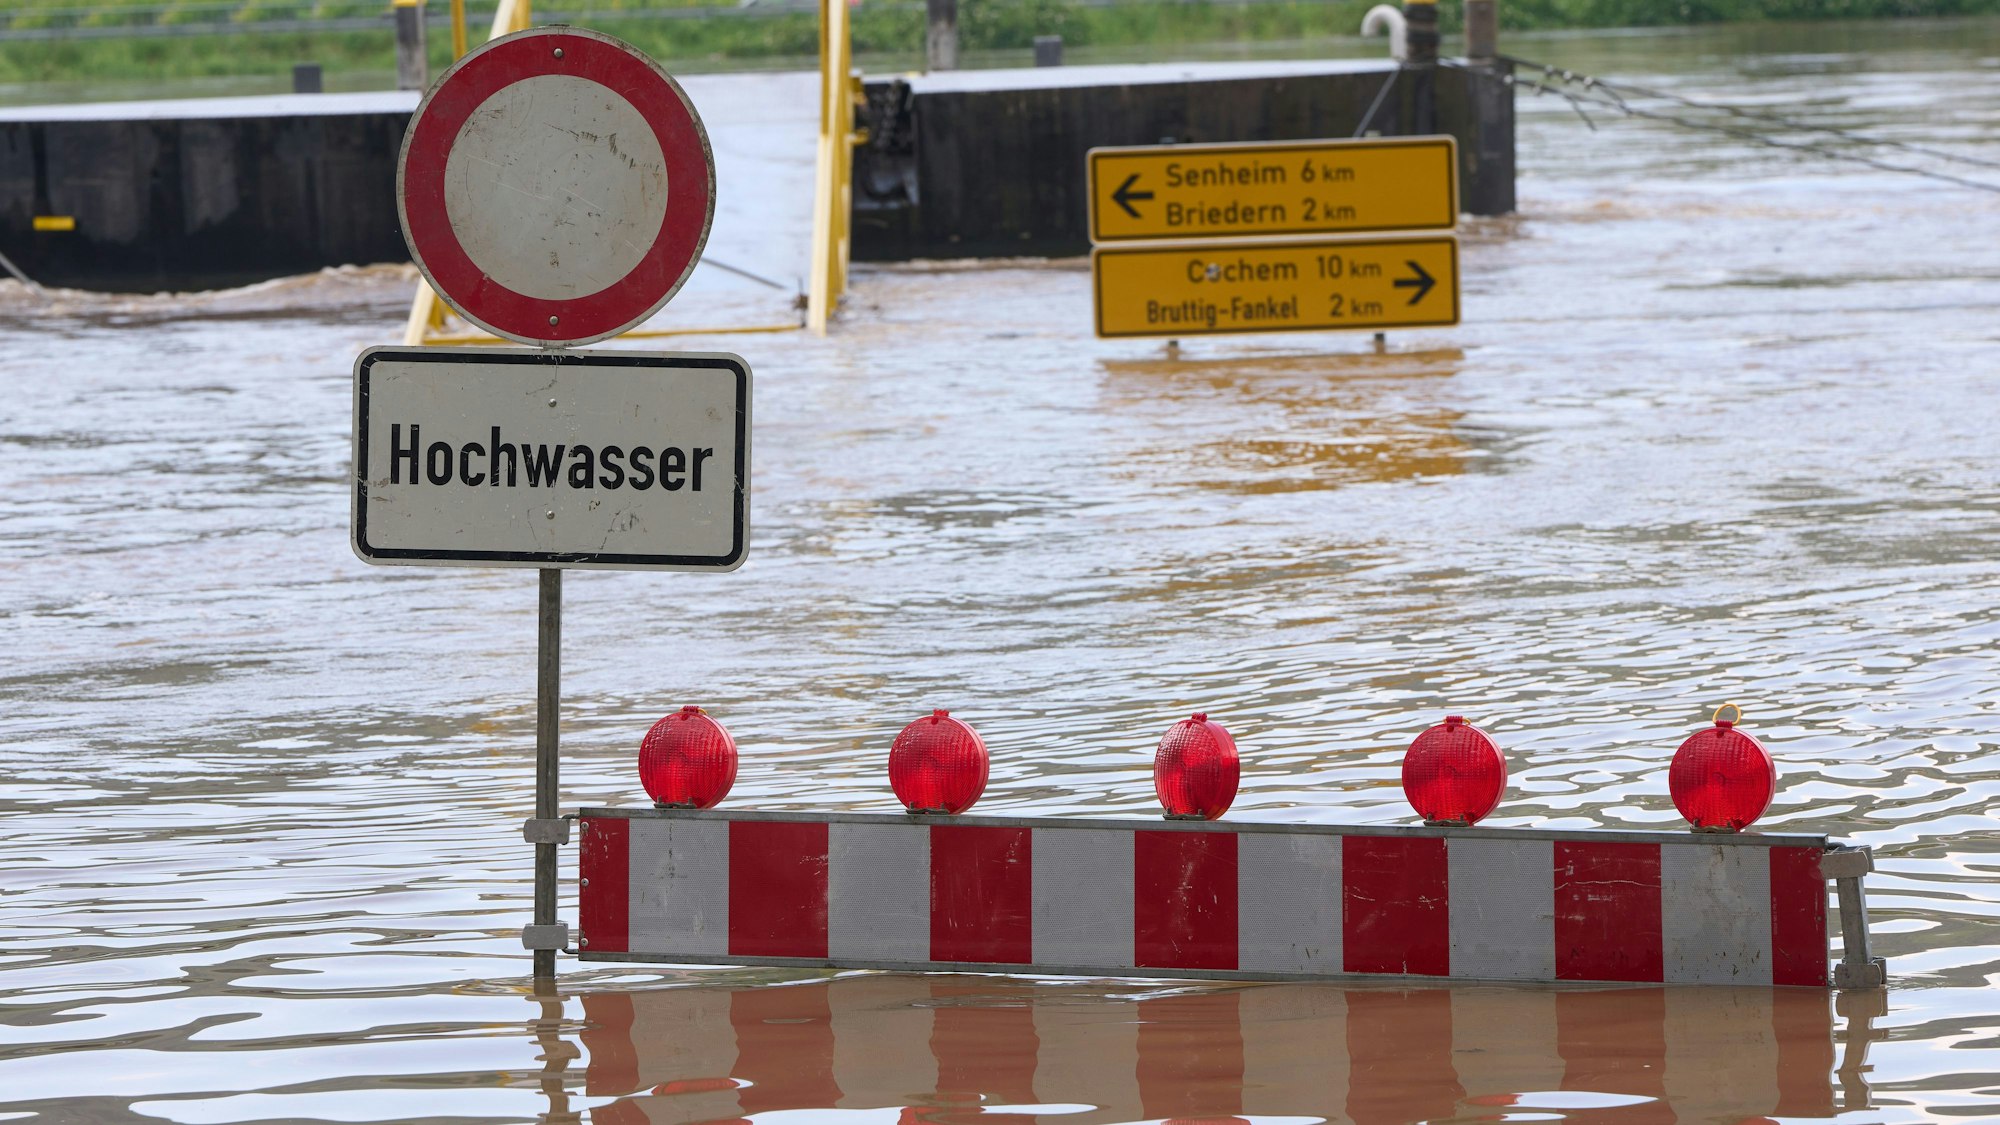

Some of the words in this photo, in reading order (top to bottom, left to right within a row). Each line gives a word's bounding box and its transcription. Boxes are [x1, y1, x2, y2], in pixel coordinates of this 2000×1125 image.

[1166, 161, 1286, 188] Senheim
[1301, 158, 1316, 183] 6
[1322, 164, 1355, 182] km
[1166, 201, 1286, 226] Briedern
[1302, 198, 1318, 222] 2
[1324, 203, 1356, 220] km
[1317, 255, 1343, 279] 10
[1350, 260, 1383, 276] km
[1146, 296, 1299, 327] Bruttig-Fankel
[1328, 293, 1344, 318] 2
[1351, 299, 1384, 316] km
[390, 423, 713, 492] Hochwasser
